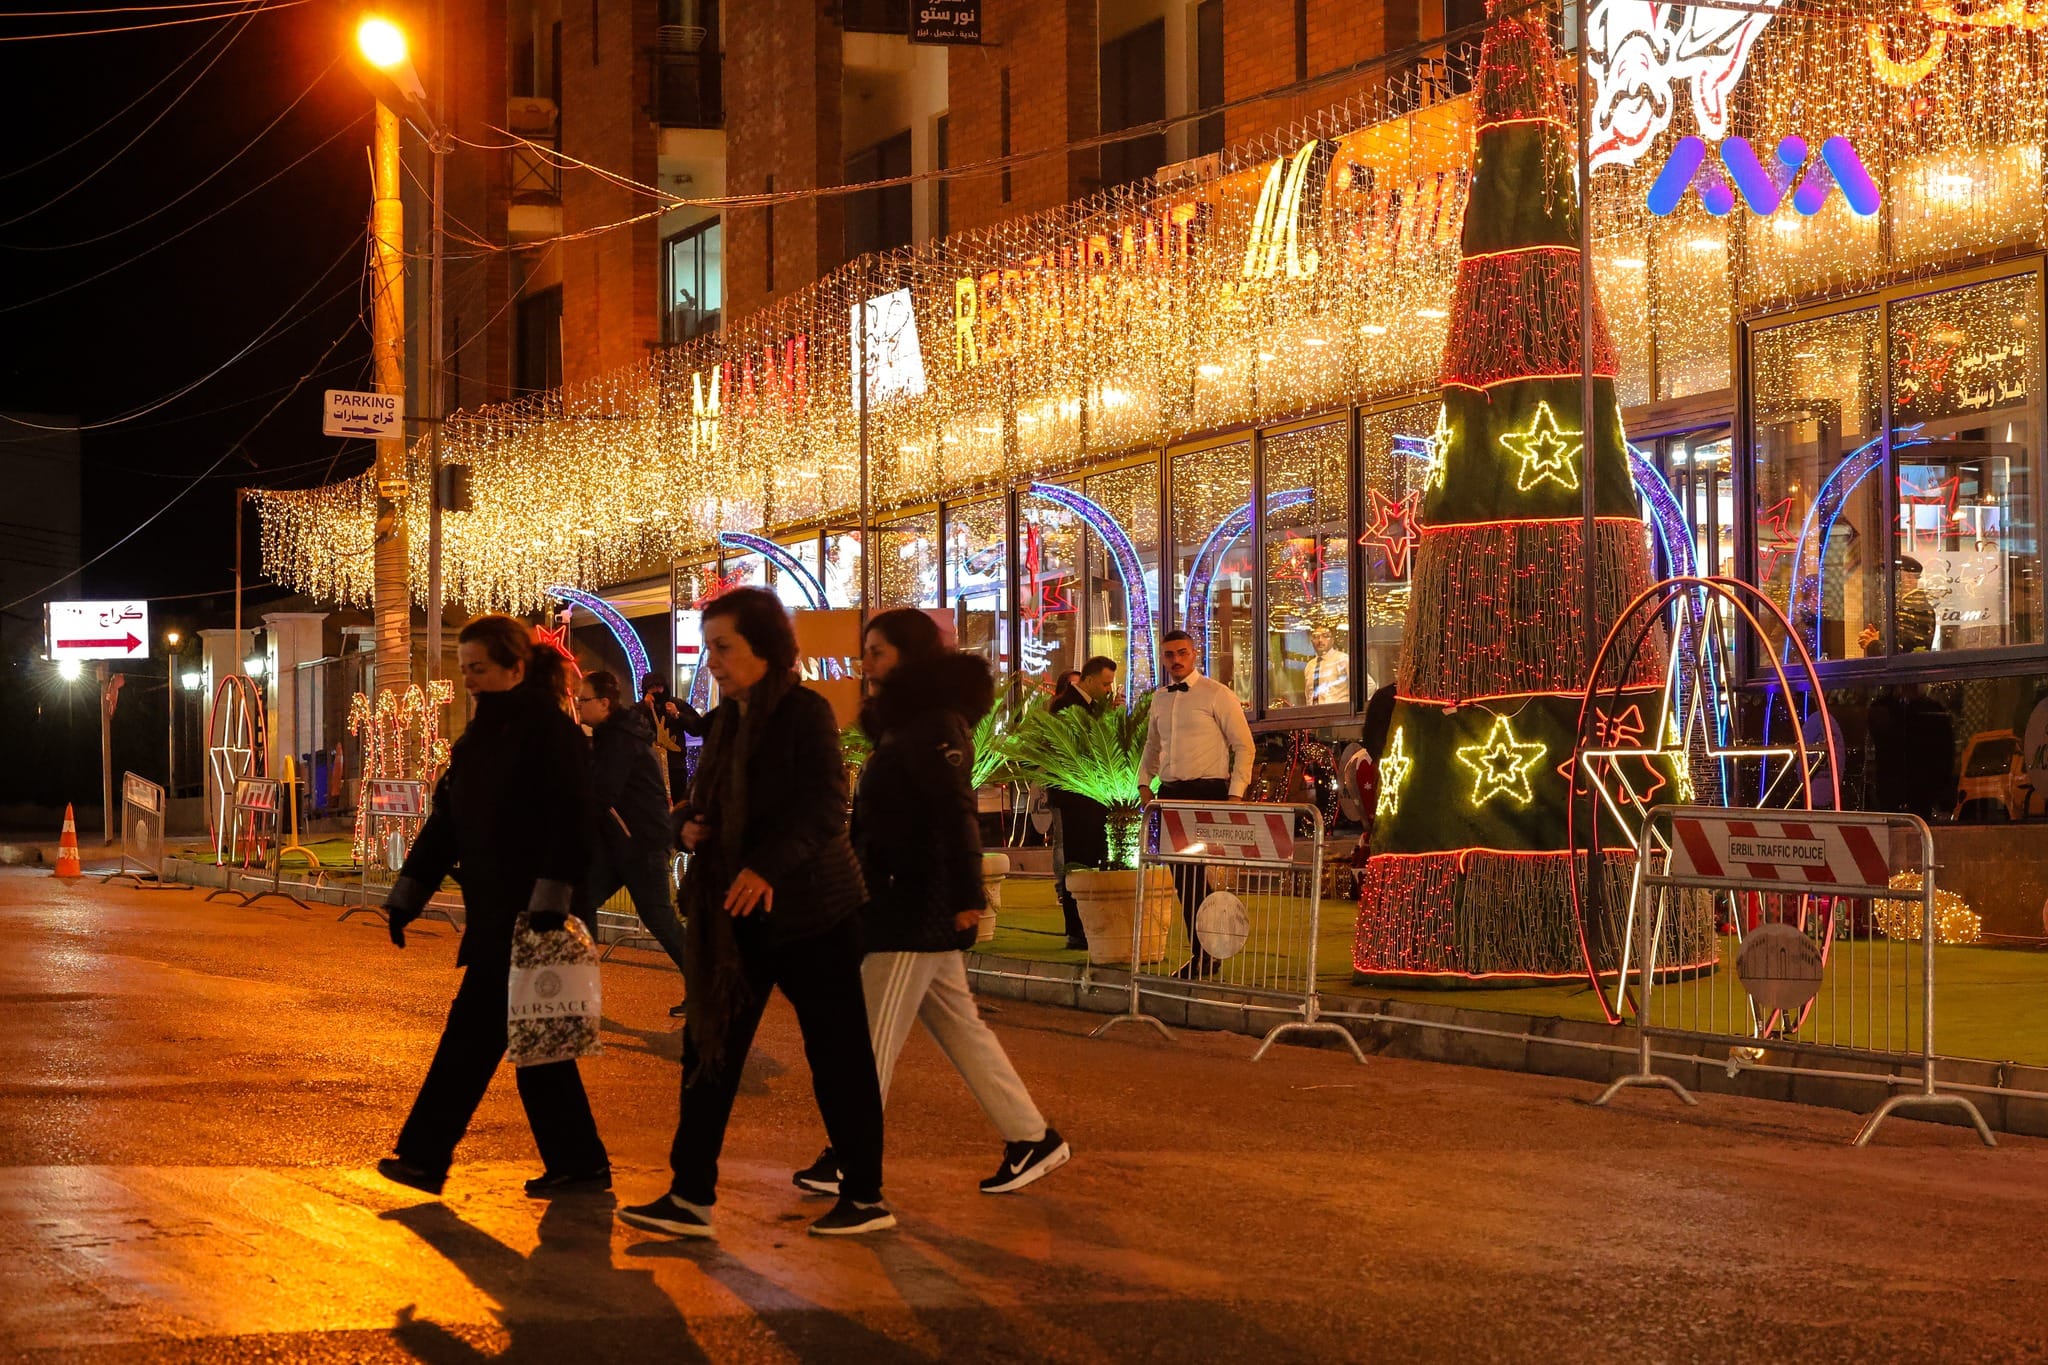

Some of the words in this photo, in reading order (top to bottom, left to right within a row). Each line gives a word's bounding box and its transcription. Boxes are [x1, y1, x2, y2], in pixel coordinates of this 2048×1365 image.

[334, 394, 395, 409] PARKING
[1940, 607, 1992, 622] iami
[1212, 828, 1234, 840] TRAFFIC
[1234, 829, 1254, 841] POLICE
[1730, 842, 1754, 857] ERBIL
[1756, 844, 1790, 858] TRAFFIC
[1792, 846, 1823, 860] POLICE
[510, 1000, 590, 1016] VERSACE
